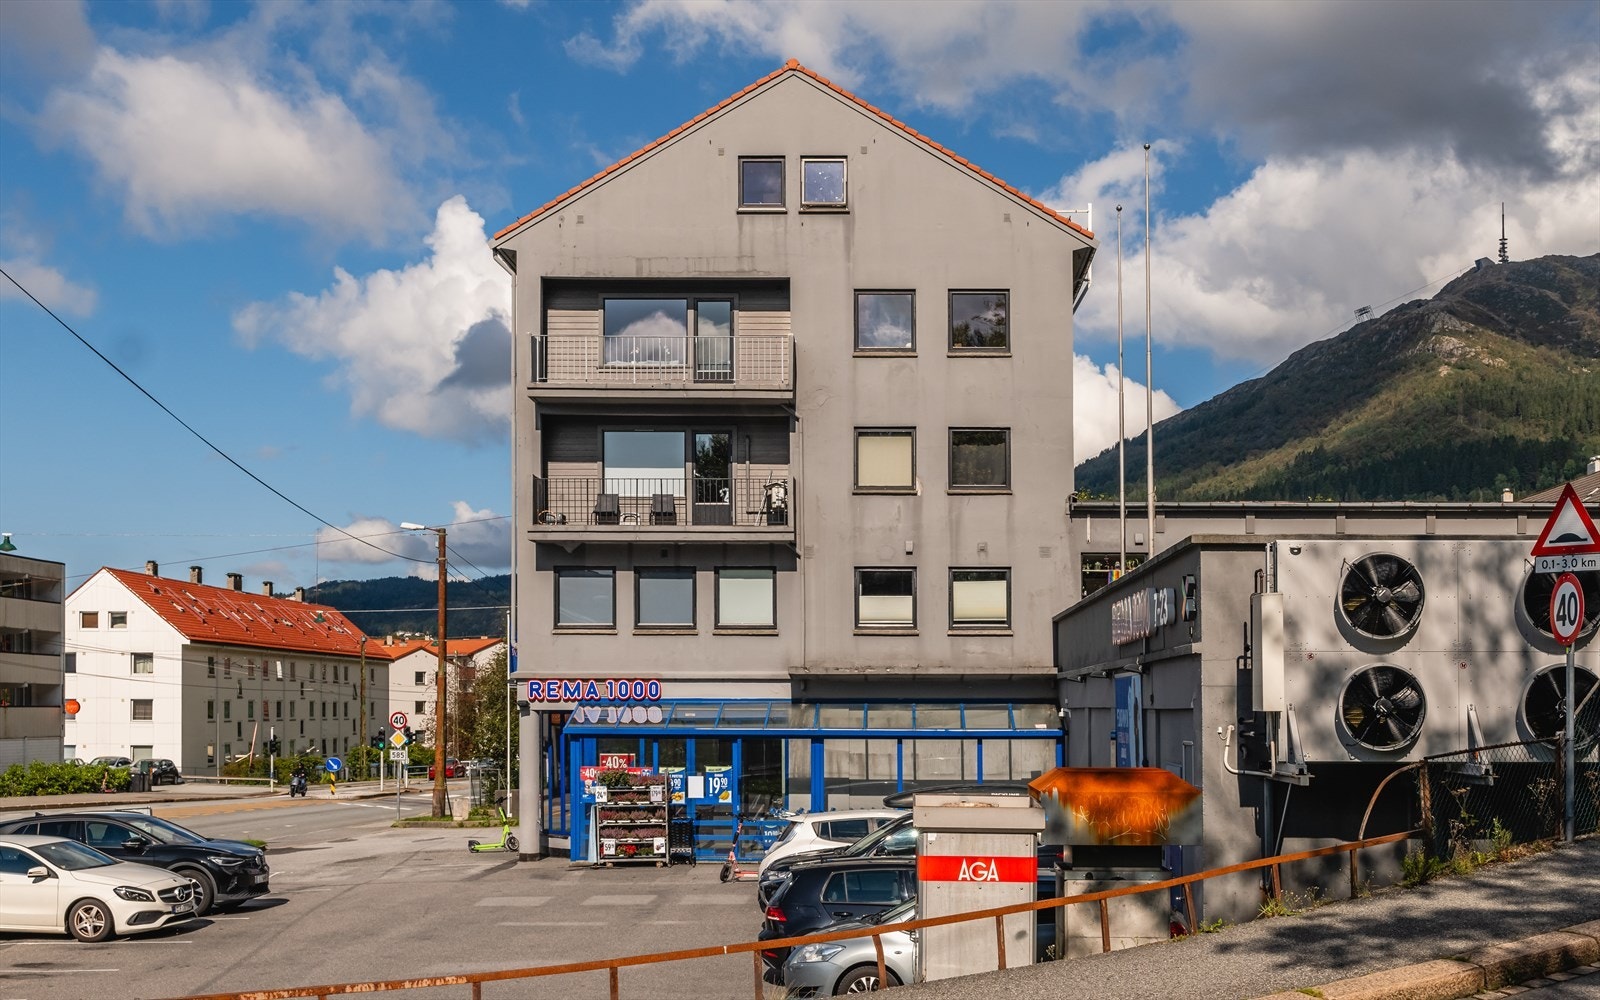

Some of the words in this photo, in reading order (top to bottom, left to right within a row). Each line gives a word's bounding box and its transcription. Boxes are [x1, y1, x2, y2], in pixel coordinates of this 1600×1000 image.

[1581, 558, 1596, 567] km
[1556, 591, 1578, 627] 40
[528, 679, 600, 701] REMA
[605, 679, 662, 701] 1000
[394, 716, 404, 724] 40
[602, 756, 628, 768] -40%
[958, 858, 999, 881] AGA
